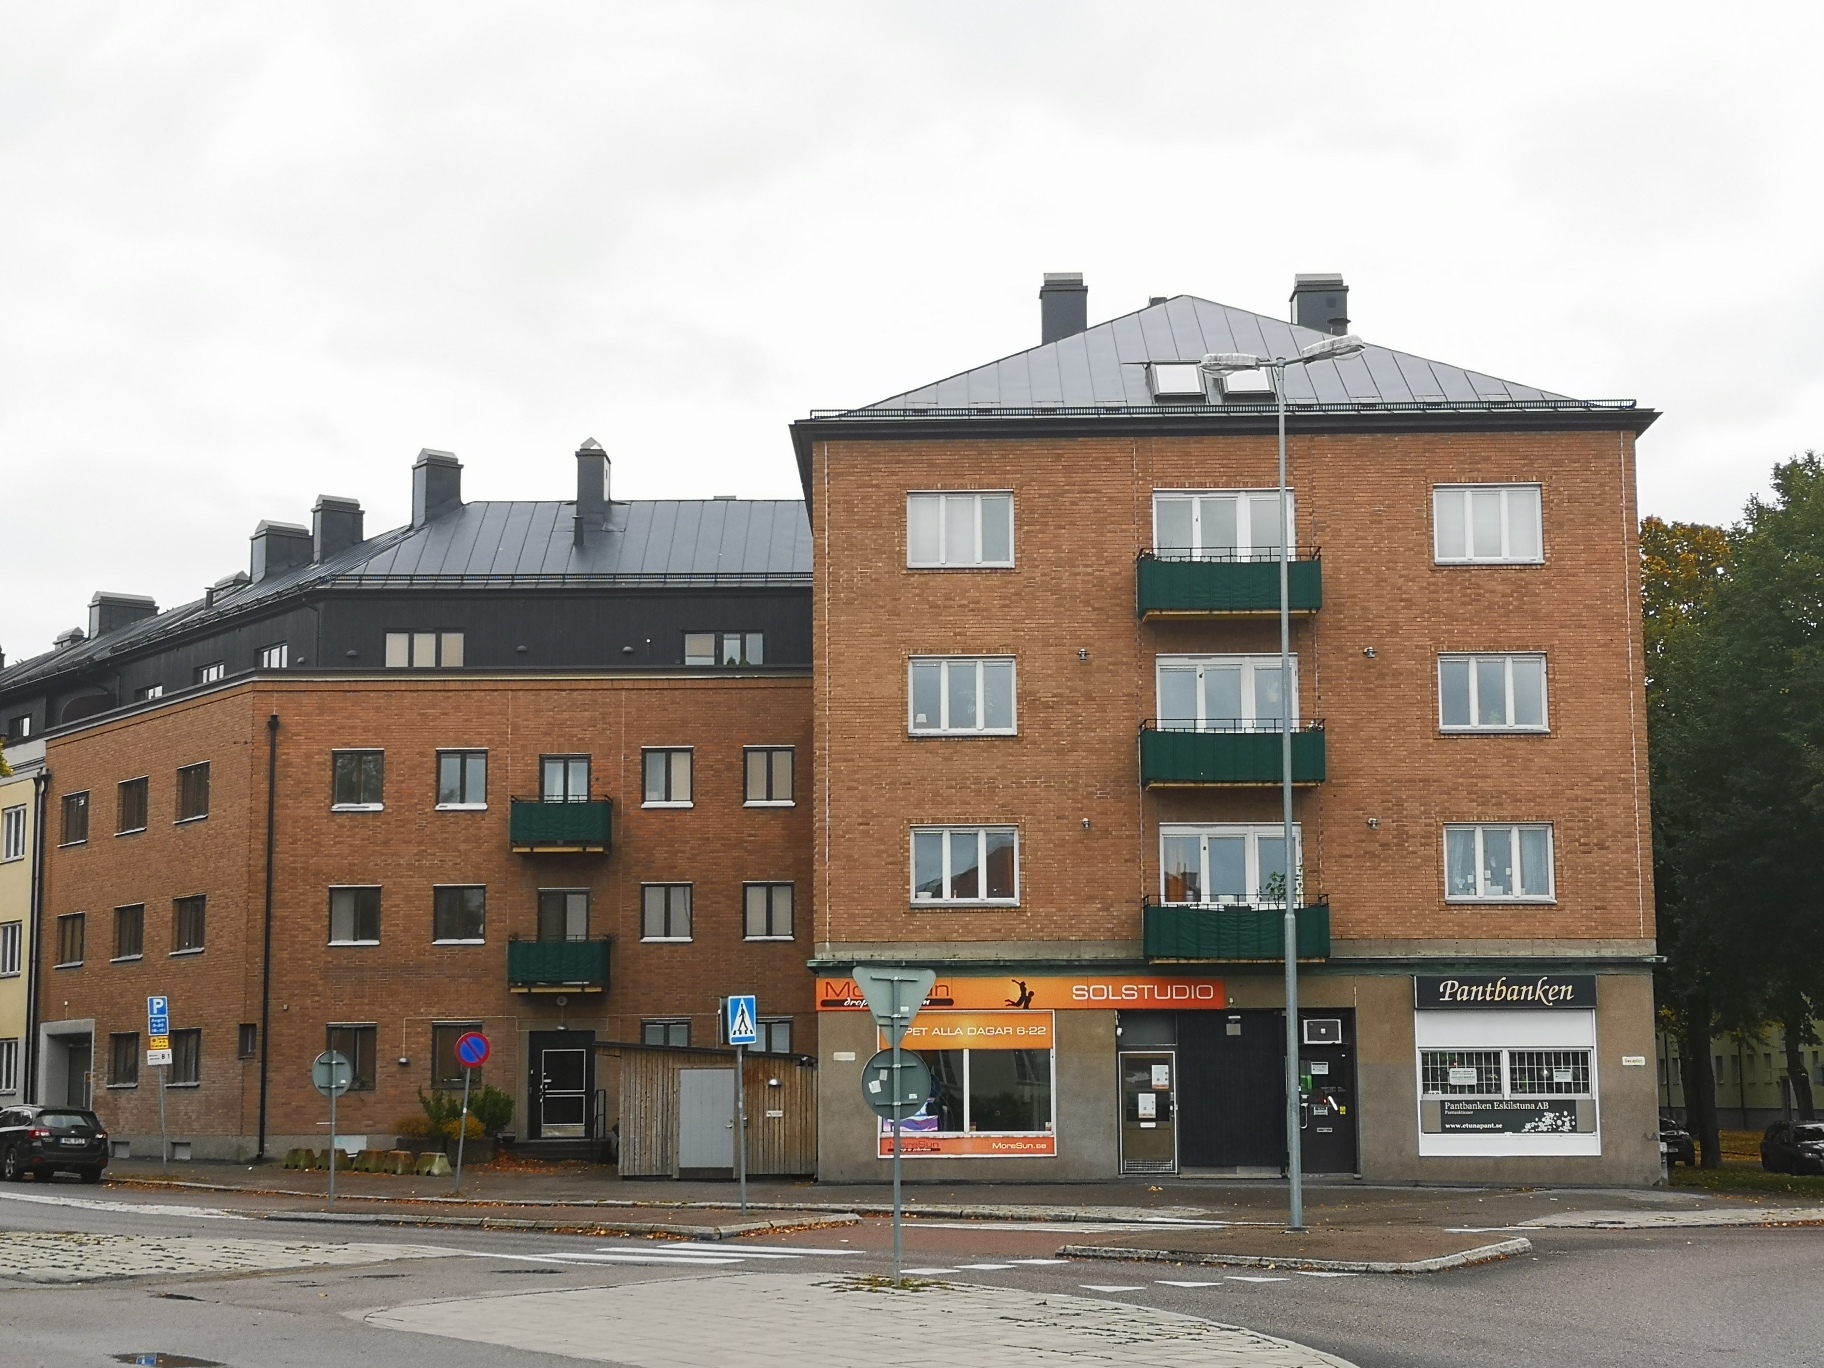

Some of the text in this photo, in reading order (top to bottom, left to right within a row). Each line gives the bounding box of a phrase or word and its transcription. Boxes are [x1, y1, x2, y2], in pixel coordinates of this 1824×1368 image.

[1072, 984, 1214, 1000] SOLSTUDIO
[1440, 977, 1574, 1006] Pantbanken
[153, 998, 164, 1014] P
[904, 1026, 1047, 1036] PET ALLA DAGAR 6-22
[1444, 1101, 1549, 1110] Pantbanken Eskilstuna AB
[1445, 1122, 1503, 1130] www.etunapant.se
